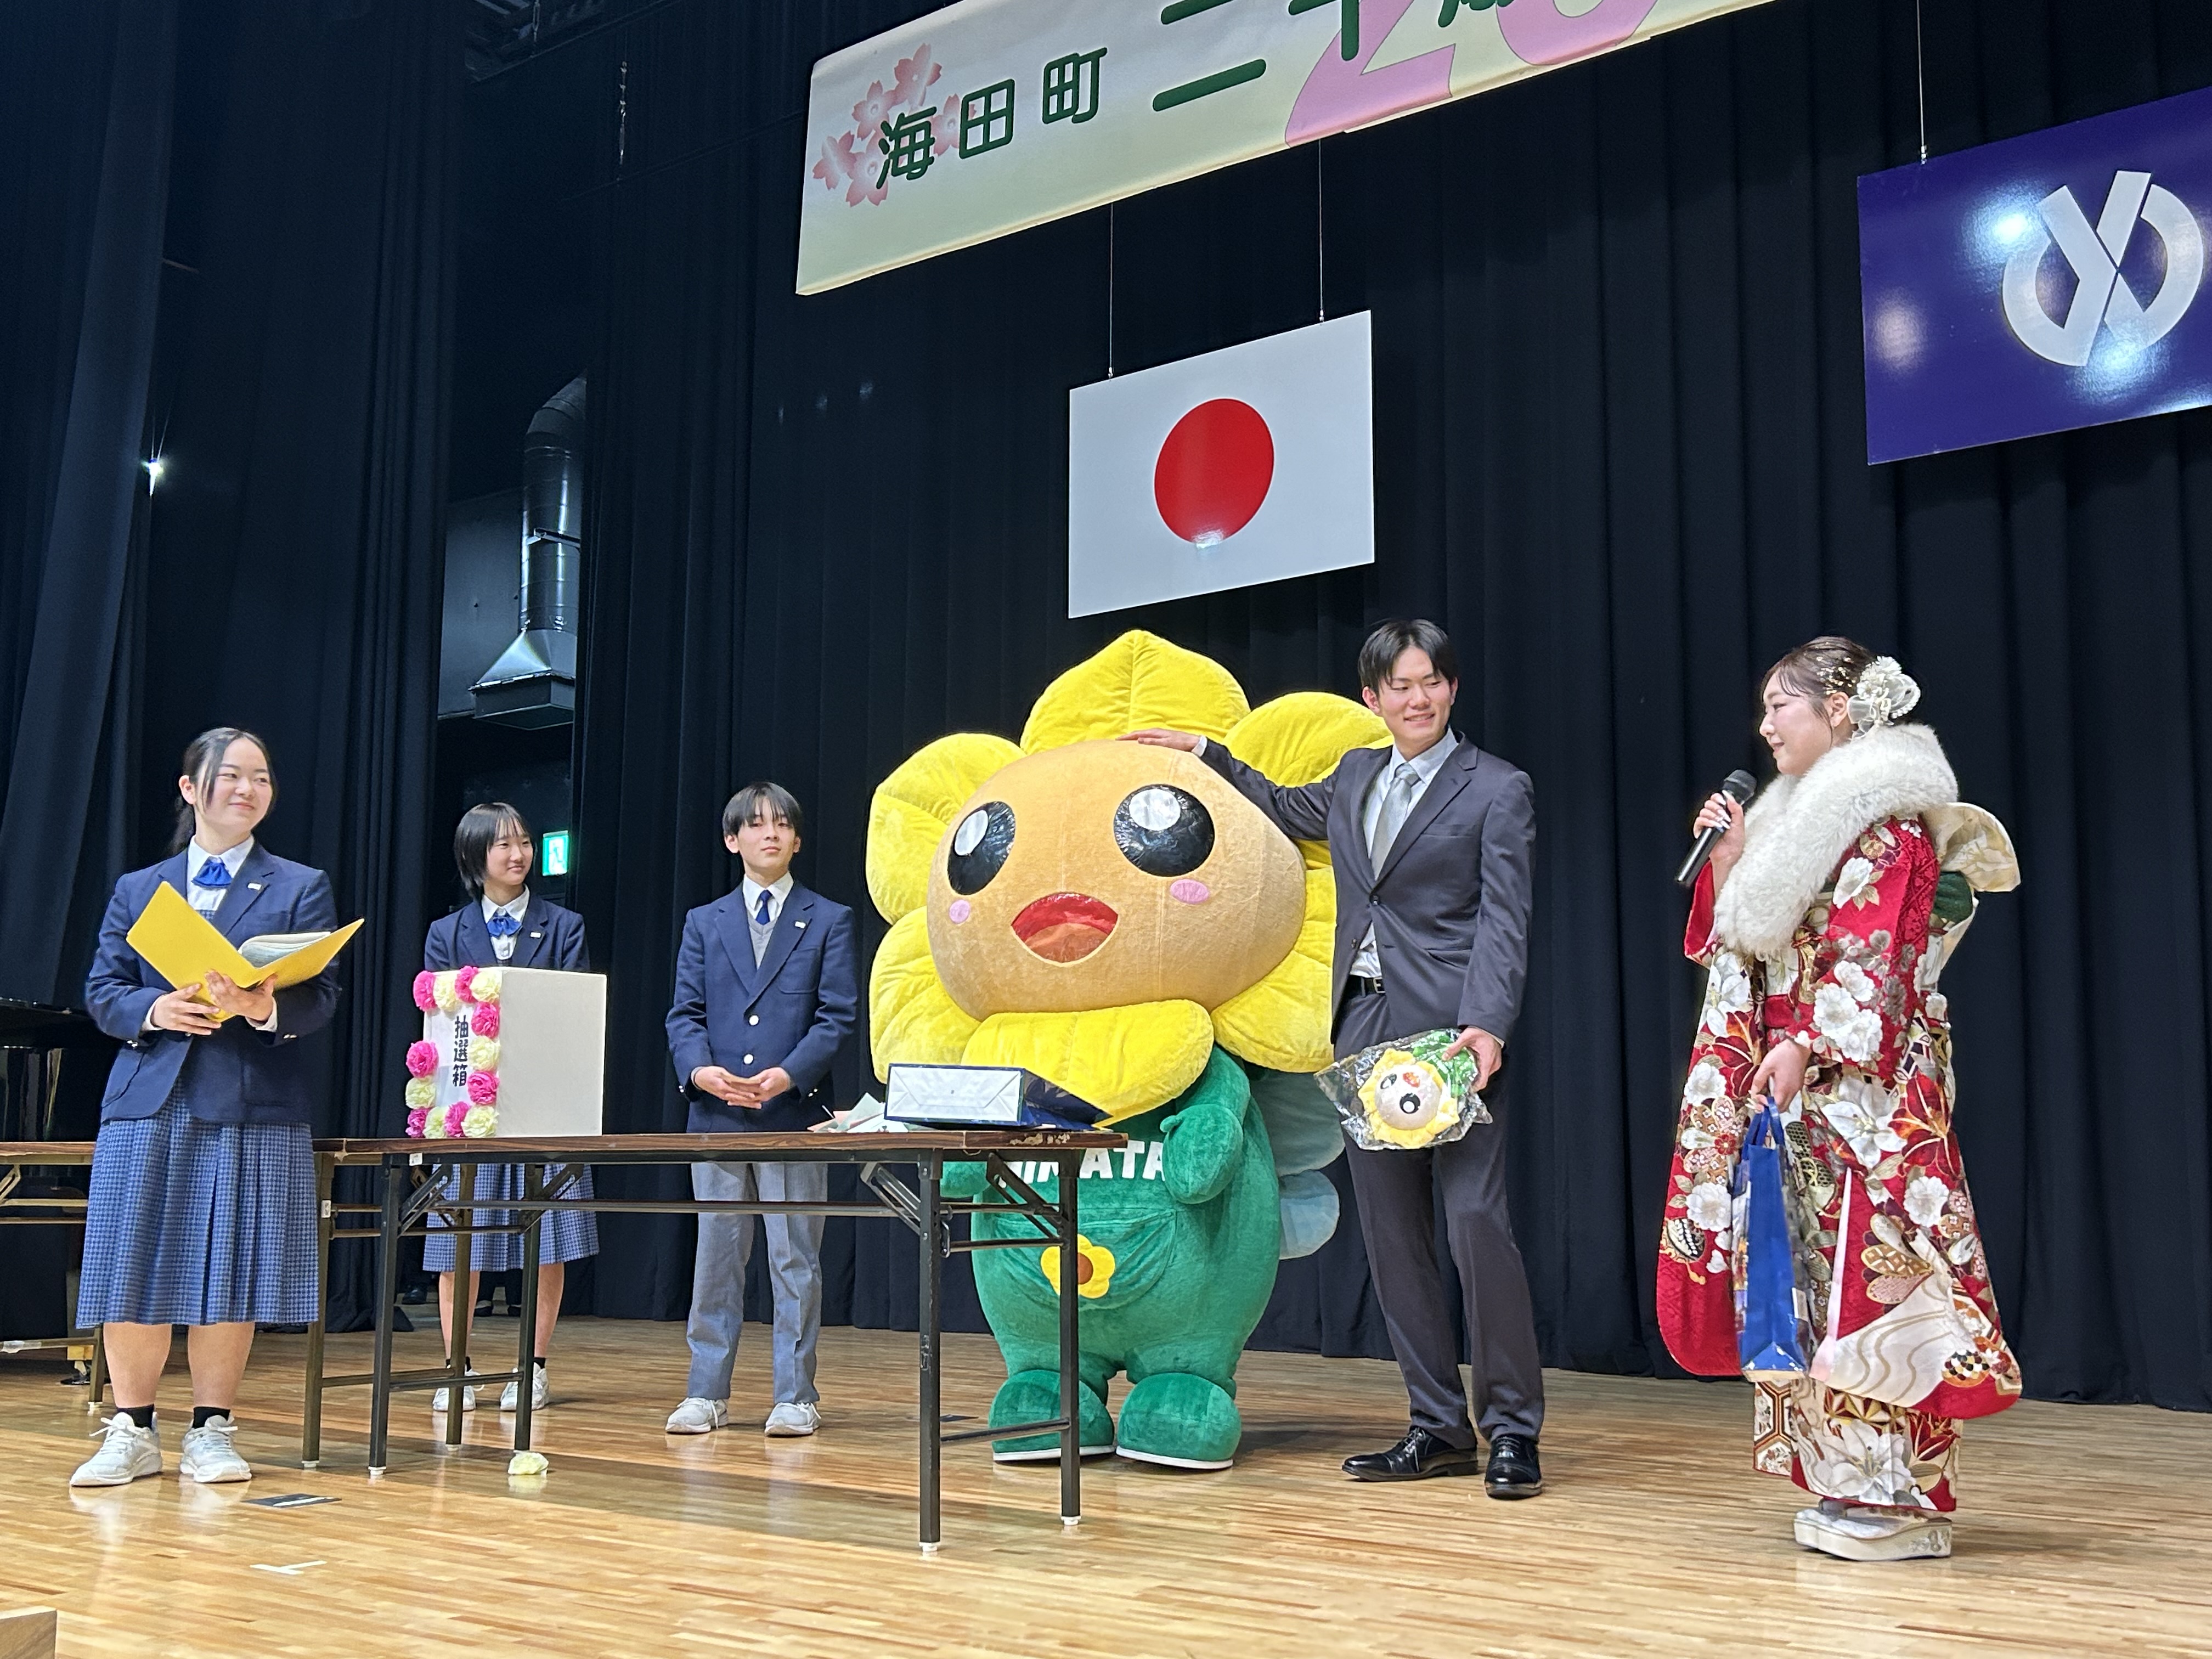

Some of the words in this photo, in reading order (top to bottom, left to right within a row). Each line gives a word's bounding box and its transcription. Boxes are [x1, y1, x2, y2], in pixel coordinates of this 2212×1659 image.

[876, 47, 1107, 190] 海田町
[1153, 0, 1511, 112] 二十
[453, 1014, 469, 1087] 抽選箱
